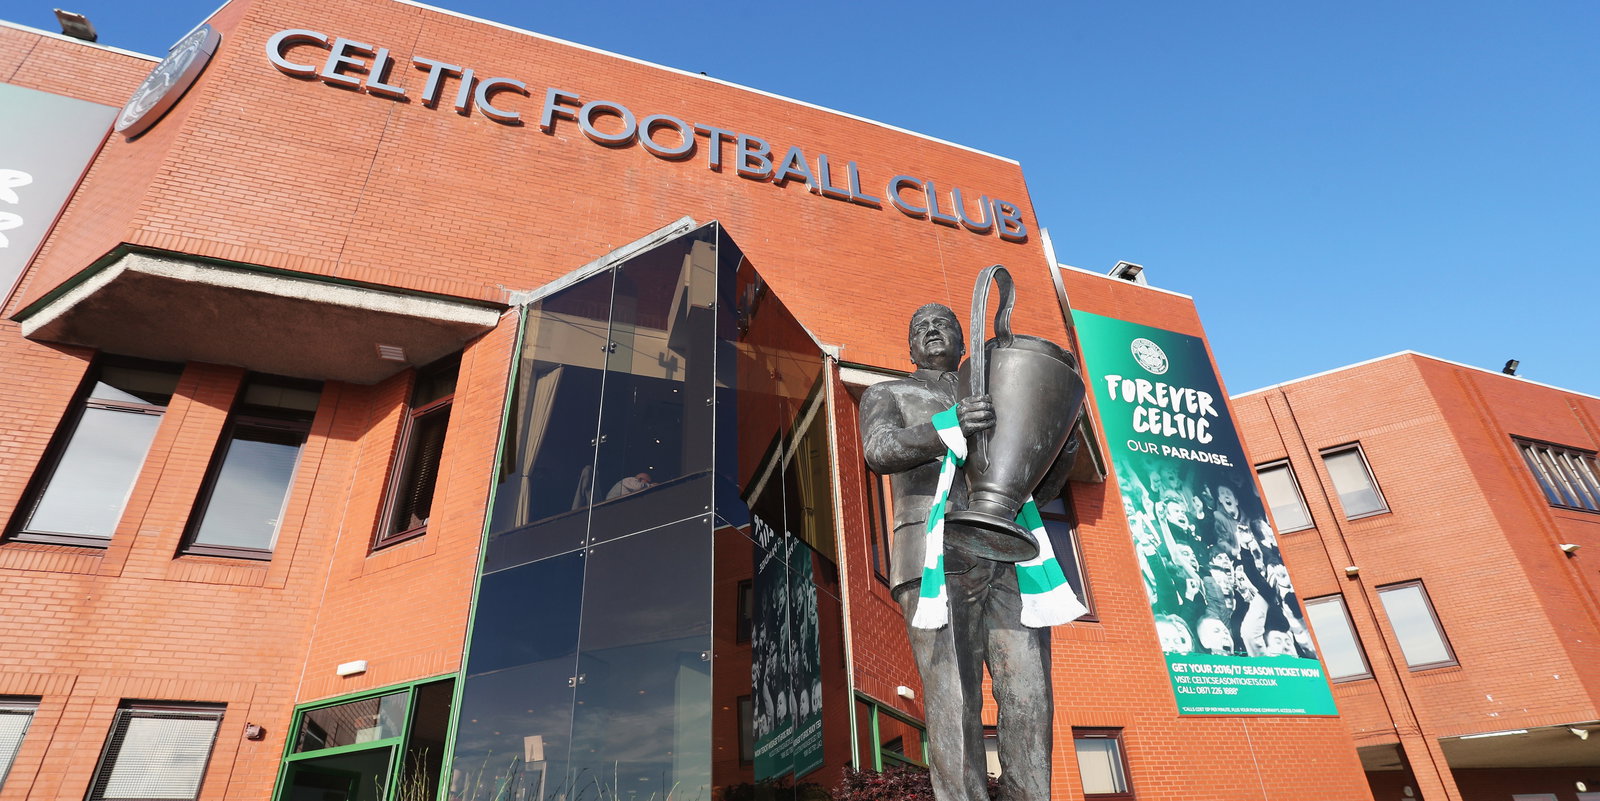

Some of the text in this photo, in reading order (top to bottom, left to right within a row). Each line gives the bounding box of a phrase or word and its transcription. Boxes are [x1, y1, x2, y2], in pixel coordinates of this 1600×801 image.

[265, 29, 528, 125] CELTIC
[540, 87, 881, 209] FOOTBALL
[887, 175, 1027, 242] CLUB
[1104, 374, 1218, 417] FOREVER
[1132, 405, 1213, 444] CELTIC
[1127, 439, 1233, 467] OUR PARADISE.
[1171, 663, 1320, 678] GET YOUR 2016/17 SEASON TICKET NOW
[1191, 676, 1278, 686] CELTICSEASONTICKETS.CO.UK
[1177, 686, 1196, 694] CALL:
[1196, 686, 1211, 694] 0871
[1211, 687, 1223, 695] 226
